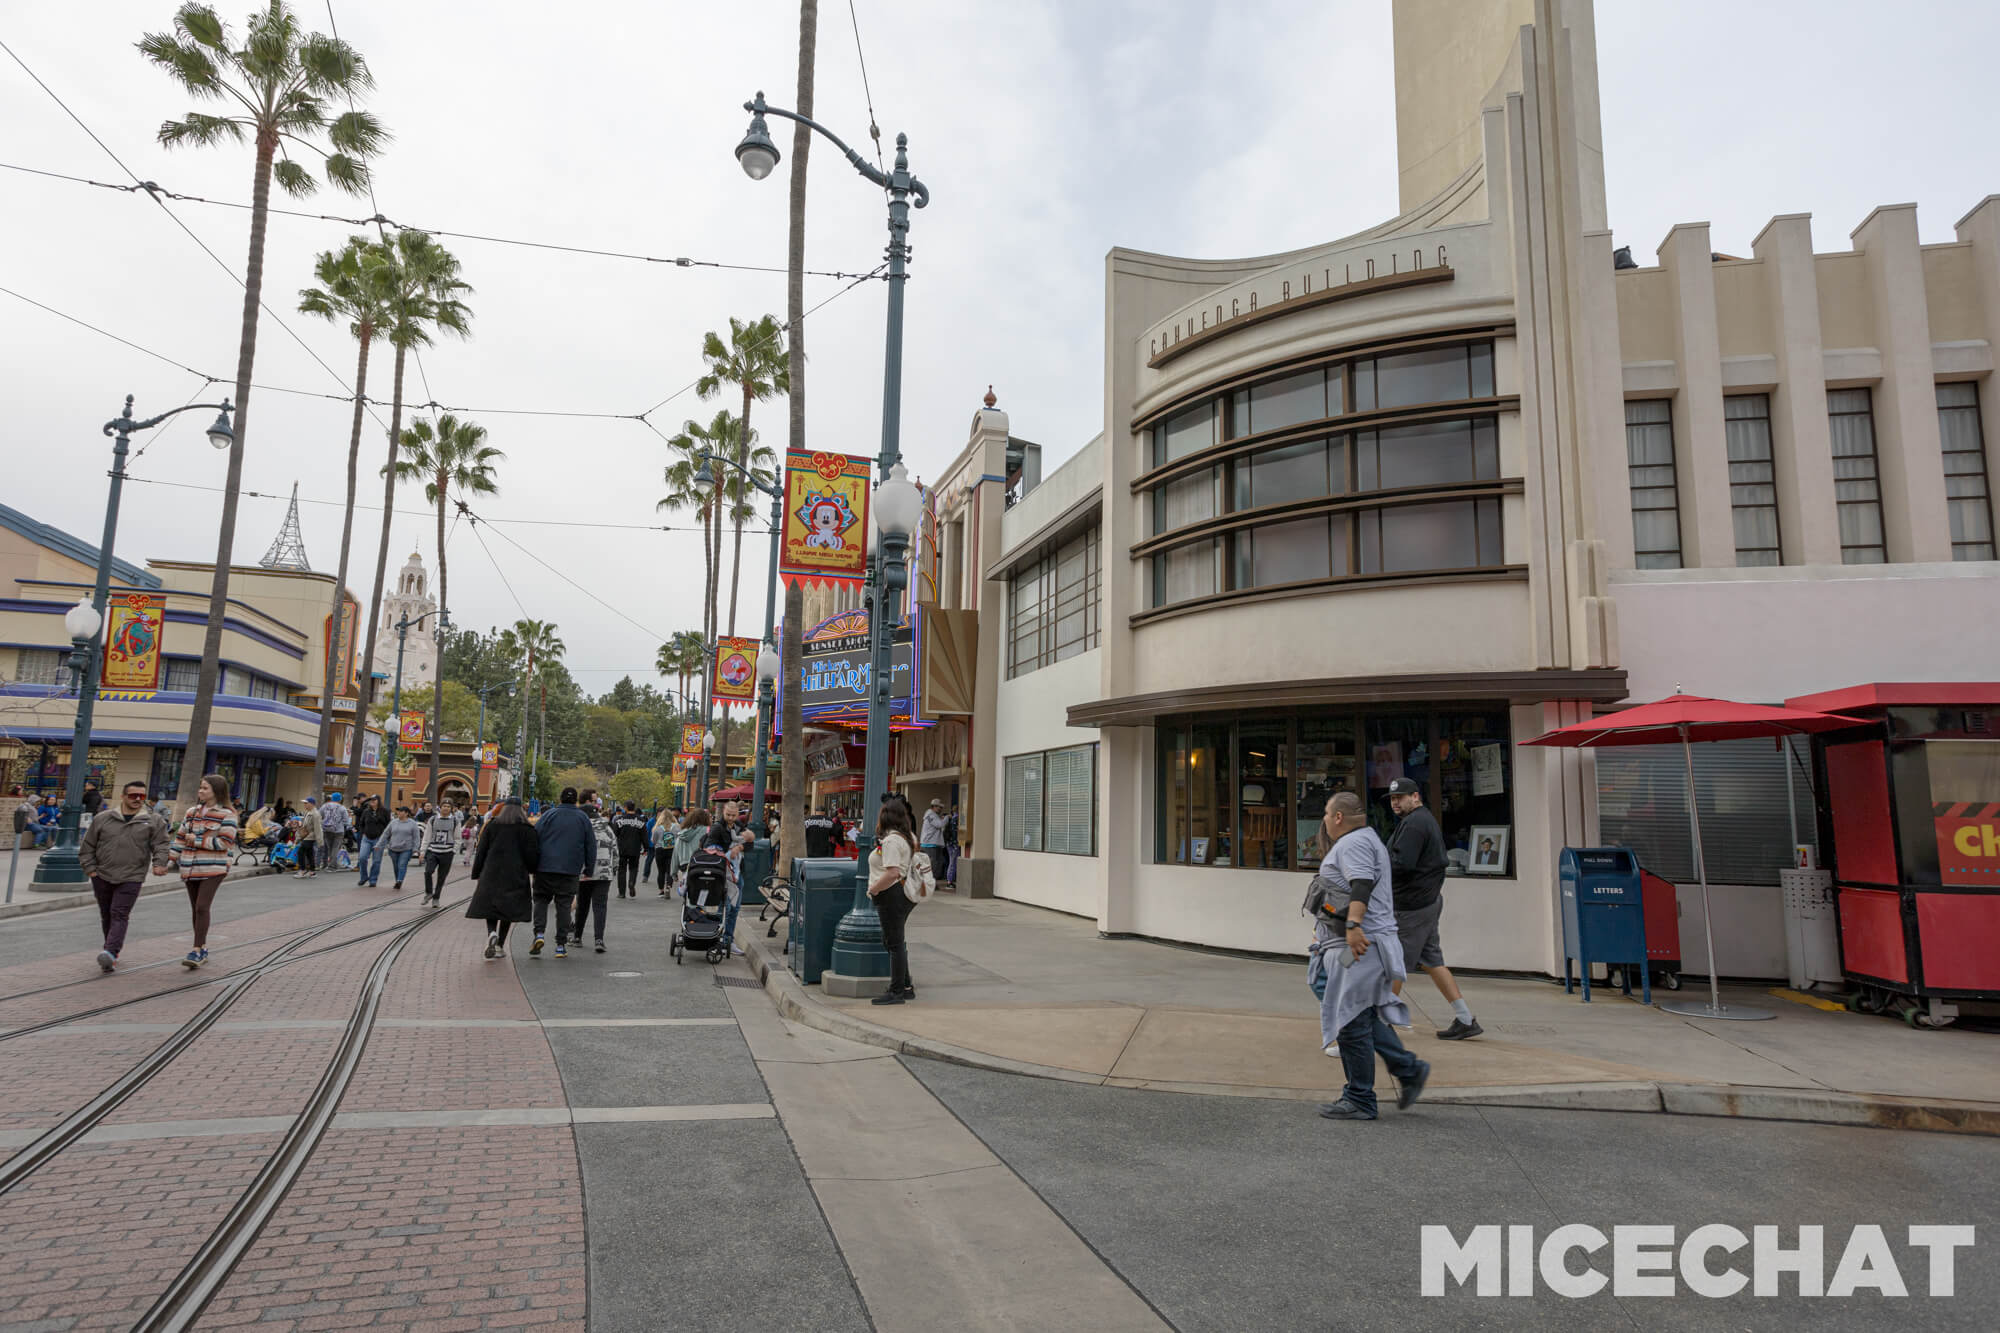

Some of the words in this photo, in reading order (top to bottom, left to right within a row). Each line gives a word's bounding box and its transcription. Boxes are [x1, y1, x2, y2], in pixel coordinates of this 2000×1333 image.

[1150, 291, 1257, 357] CAHUENGA
[1283, 245, 1447, 302] BUILDING
[810, 639, 842, 651] SUNSET
[811, 659, 851, 677] Mickey's
